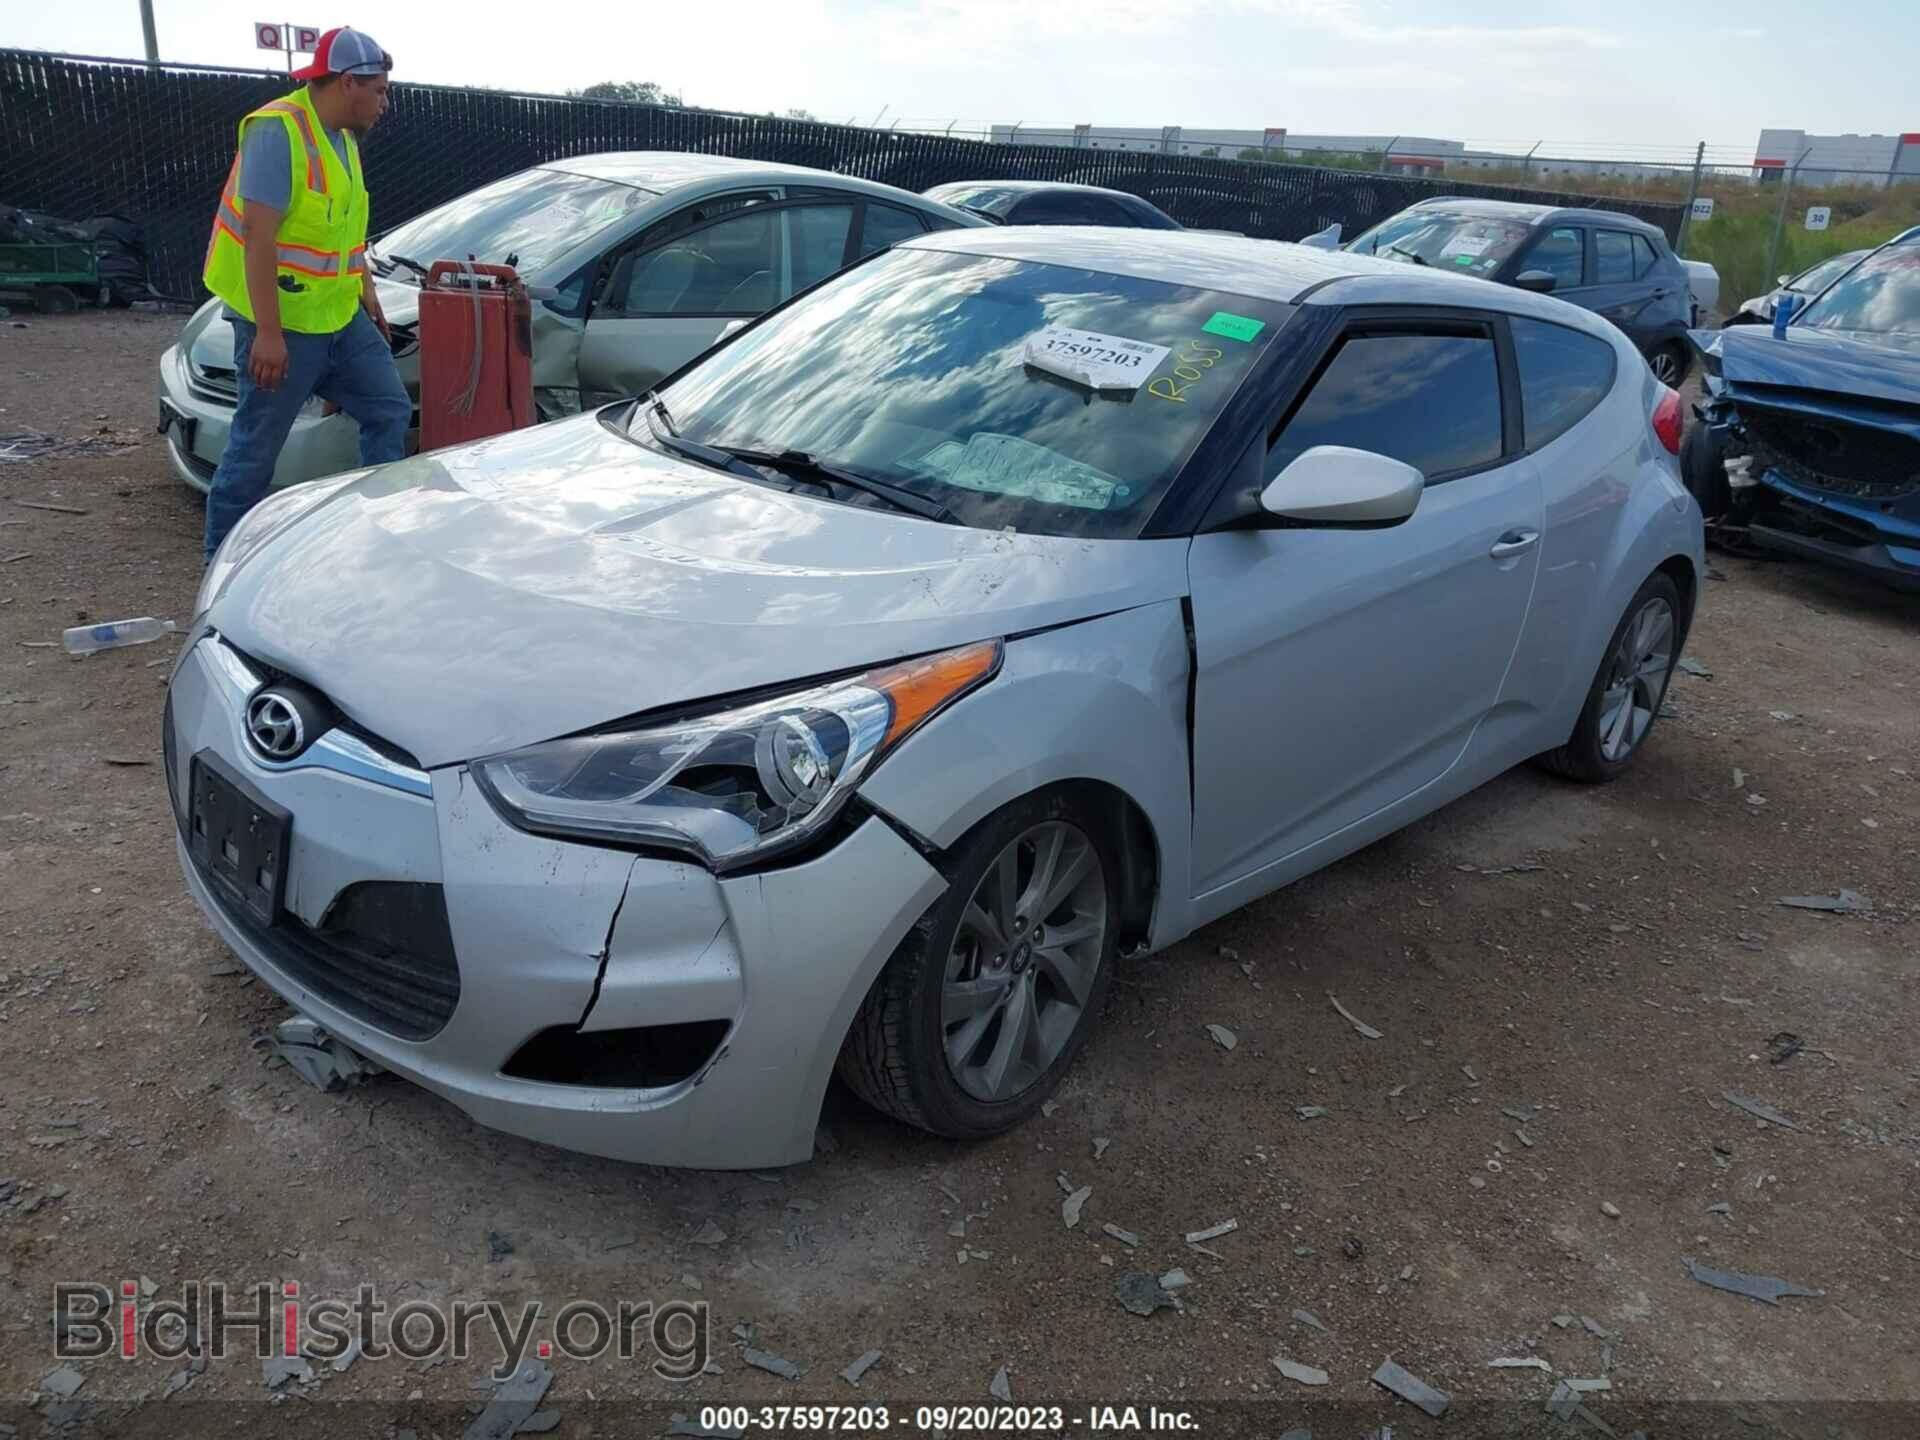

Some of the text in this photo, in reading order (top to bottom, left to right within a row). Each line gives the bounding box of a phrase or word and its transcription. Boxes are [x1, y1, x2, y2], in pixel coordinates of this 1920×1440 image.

[259, 26, 279, 48] Q
[300, 30, 316, 49] P
[1046, 339, 1142, 367] 37597203
[1148, 340, 1222, 402] ROSS
